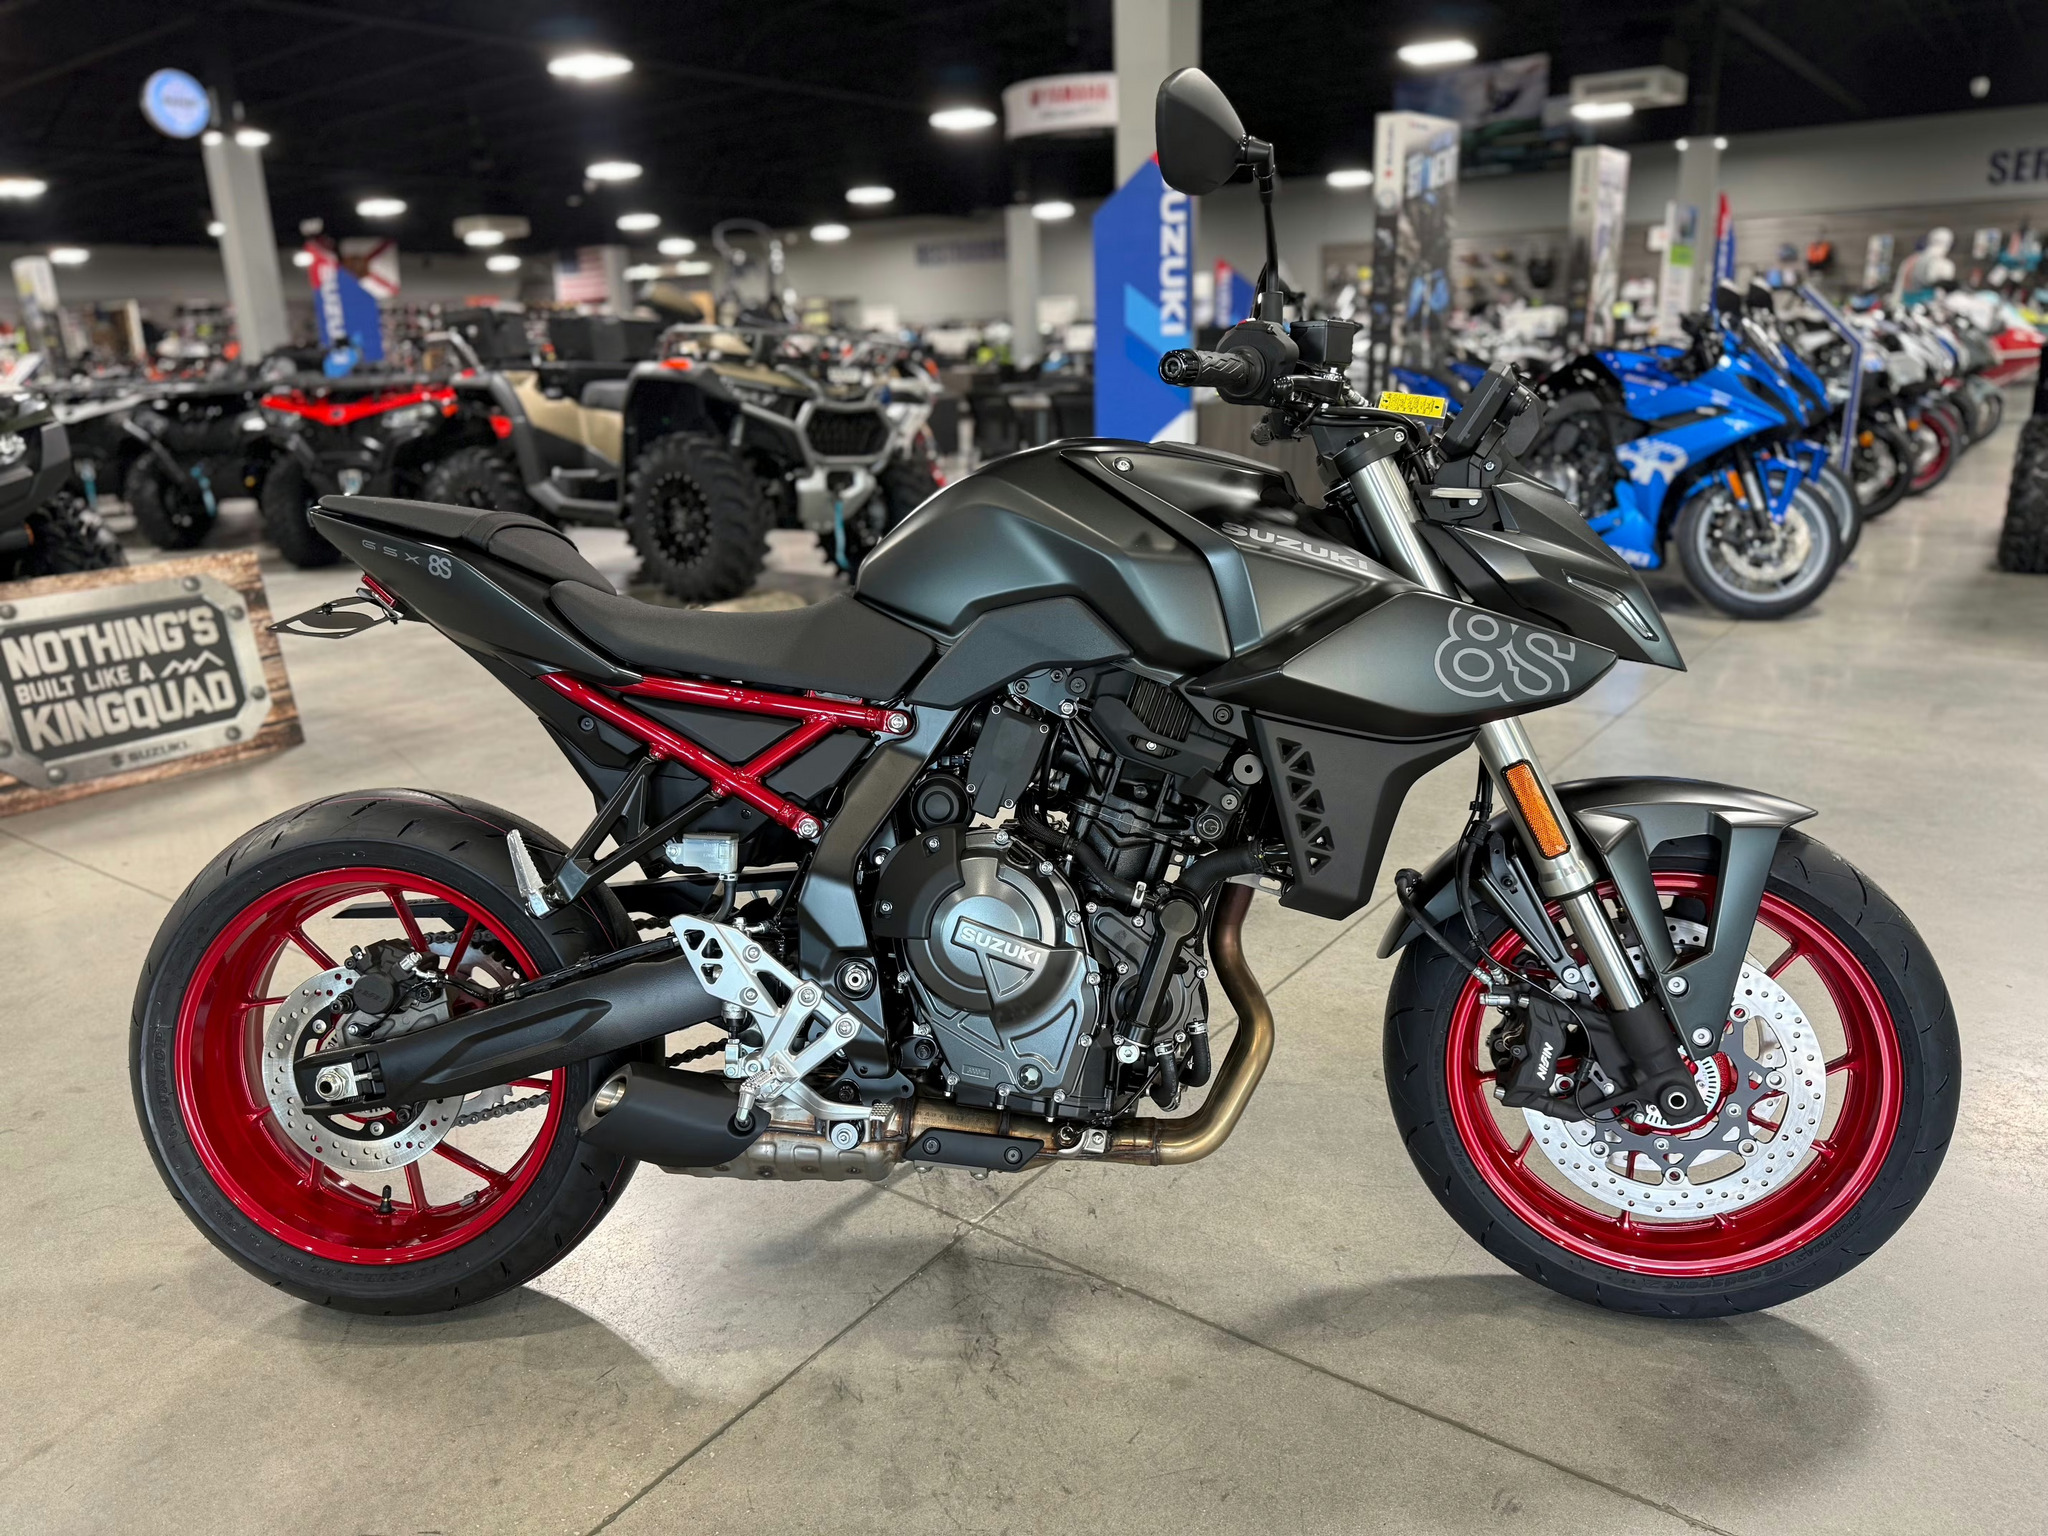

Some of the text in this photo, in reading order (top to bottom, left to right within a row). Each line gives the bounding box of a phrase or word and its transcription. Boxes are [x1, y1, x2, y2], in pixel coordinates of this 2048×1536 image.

[1159, 178, 1188, 337] UZUKI
[428, 554, 452, 579] 8S
[1221, 522, 1368, 570] SUZUKI
[1, 605, 220, 681] NOTHING'S
[14, 661, 156, 706] BUILT LIKE A
[21, 670, 238, 752] KINGQUAD
[128, 740, 189, 763] SUZUKI
[961, 927, 1041, 965] SUZUKI
